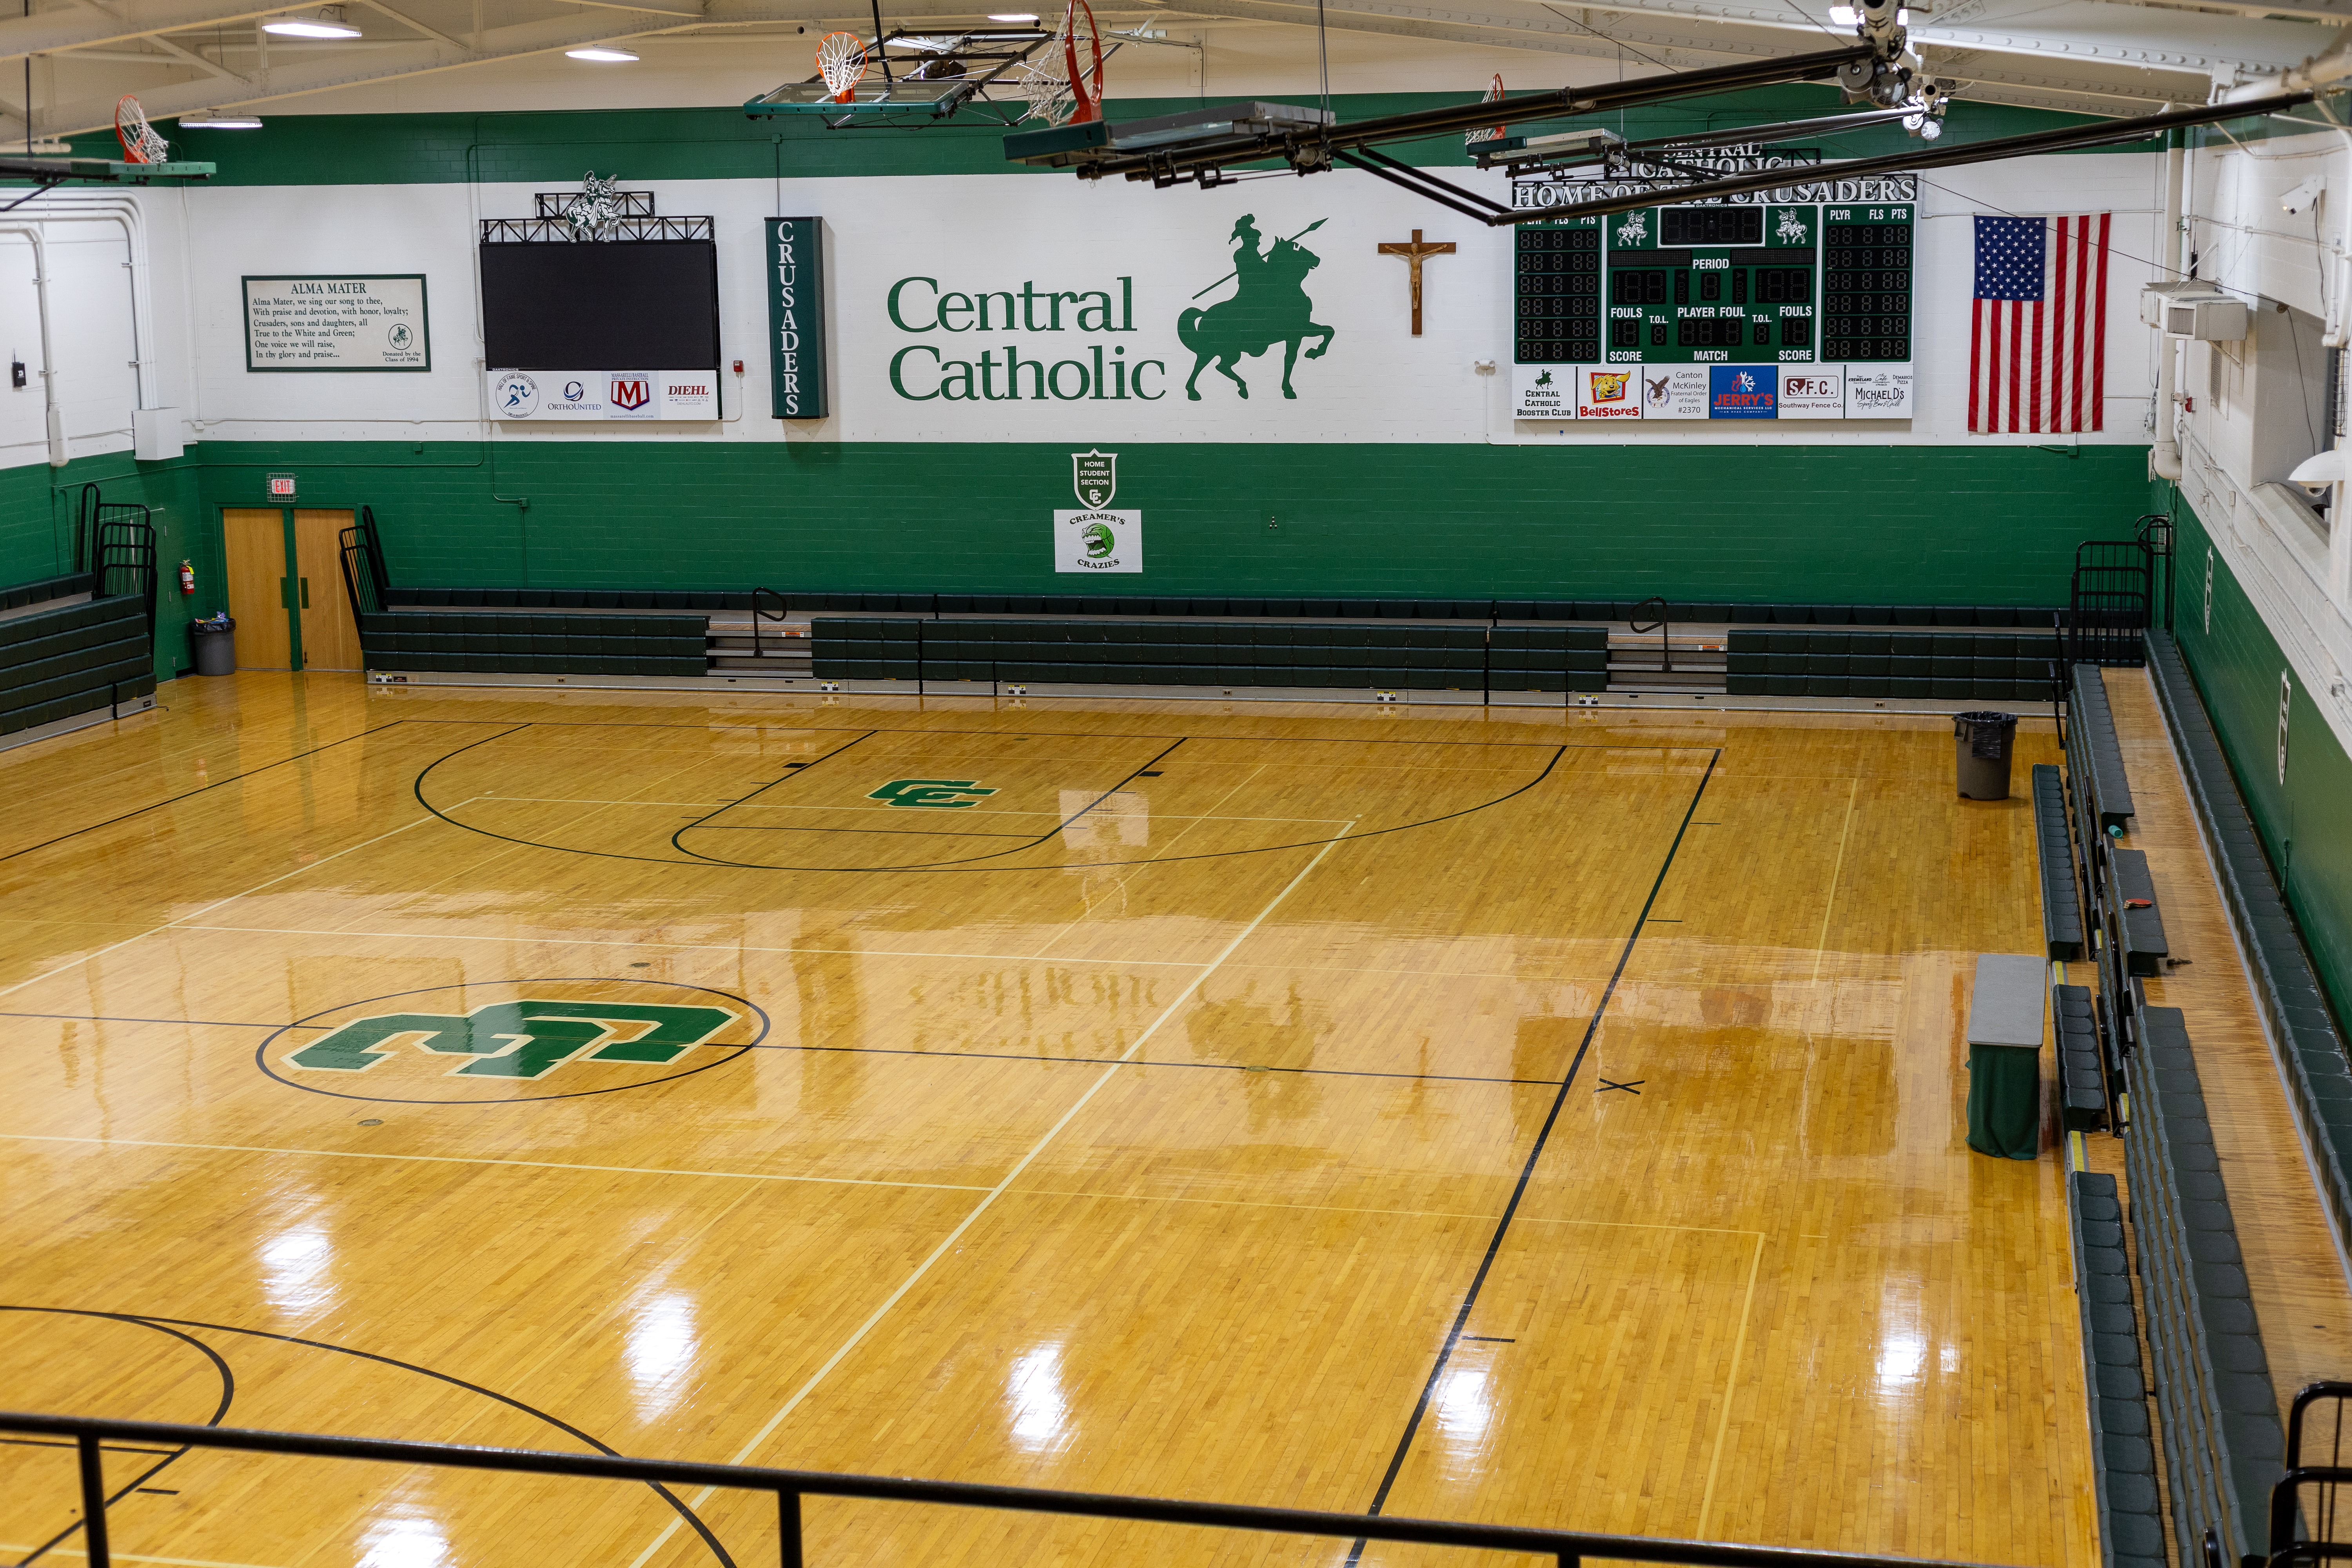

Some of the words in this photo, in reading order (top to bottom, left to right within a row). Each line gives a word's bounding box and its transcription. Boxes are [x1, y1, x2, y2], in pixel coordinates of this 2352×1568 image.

[1514, 185, 1604, 207] HOME
[1731, 180, 1915, 203] CRUSADERS
[1830, 210, 1850, 220] PLYR
[1869, 209, 1884, 220] FLS
[1891, 209, 1907, 219] PTS
[1693, 258, 1729, 269] PERIOD
[291, 283, 324, 294] ALMA
[327, 283, 367, 294] MATER
[273, 298, 295, 306] Mater,
[309, 298, 323, 306] sing
[367, 297, 383, 305] thee,
[887, 276, 1137, 332] Central
[272, 308, 292, 317] praise
[309, 308, 339, 316] devotion,
[360, 307, 381, 316] honor,
[384, 307, 408, 316] loyalty;
[1611, 308, 1642, 318] FOULS
[1677, 307, 1715, 317] PLAYER
[1720, 307, 1745, 317] FOUL
[1780, 306, 1812, 316] FOULS
[254, 319, 288, 327] Crusaders,
[322, 319, 356, 327] daughters,
[778, 221, 800, 415] CRUSADERS
[333, 329, 355, 338] Green;
[318, 340, 335, 348] raise,
[266, 350, 276, 359] thy
[279, 350, 296, 359] glory
[314, 350, 339, 359] praise...
[1610, 351, 1642, 361] SCORE
[1693, 351, 1728, 361] MATCH
[1779, 350, 1812, 360] SCORE
[889, 345, 1166, 400] Catholic
[668, 386, 709, 395] DIEHL
[1673, 382, 1706, 390] McKinley
[1789, 381, 1833, 395] S.F.C.
[1713, 393, 1773, 406] JERRY'S
[1857, 399, 1873, 410] Sports
[1887, 399, 1902, 408] Grill
[275, 480, 290, 492] EXIT
[1069, 514, 1125, 525] CREAMER'S
[1077, 559, 1120, 568] CRAZIES
